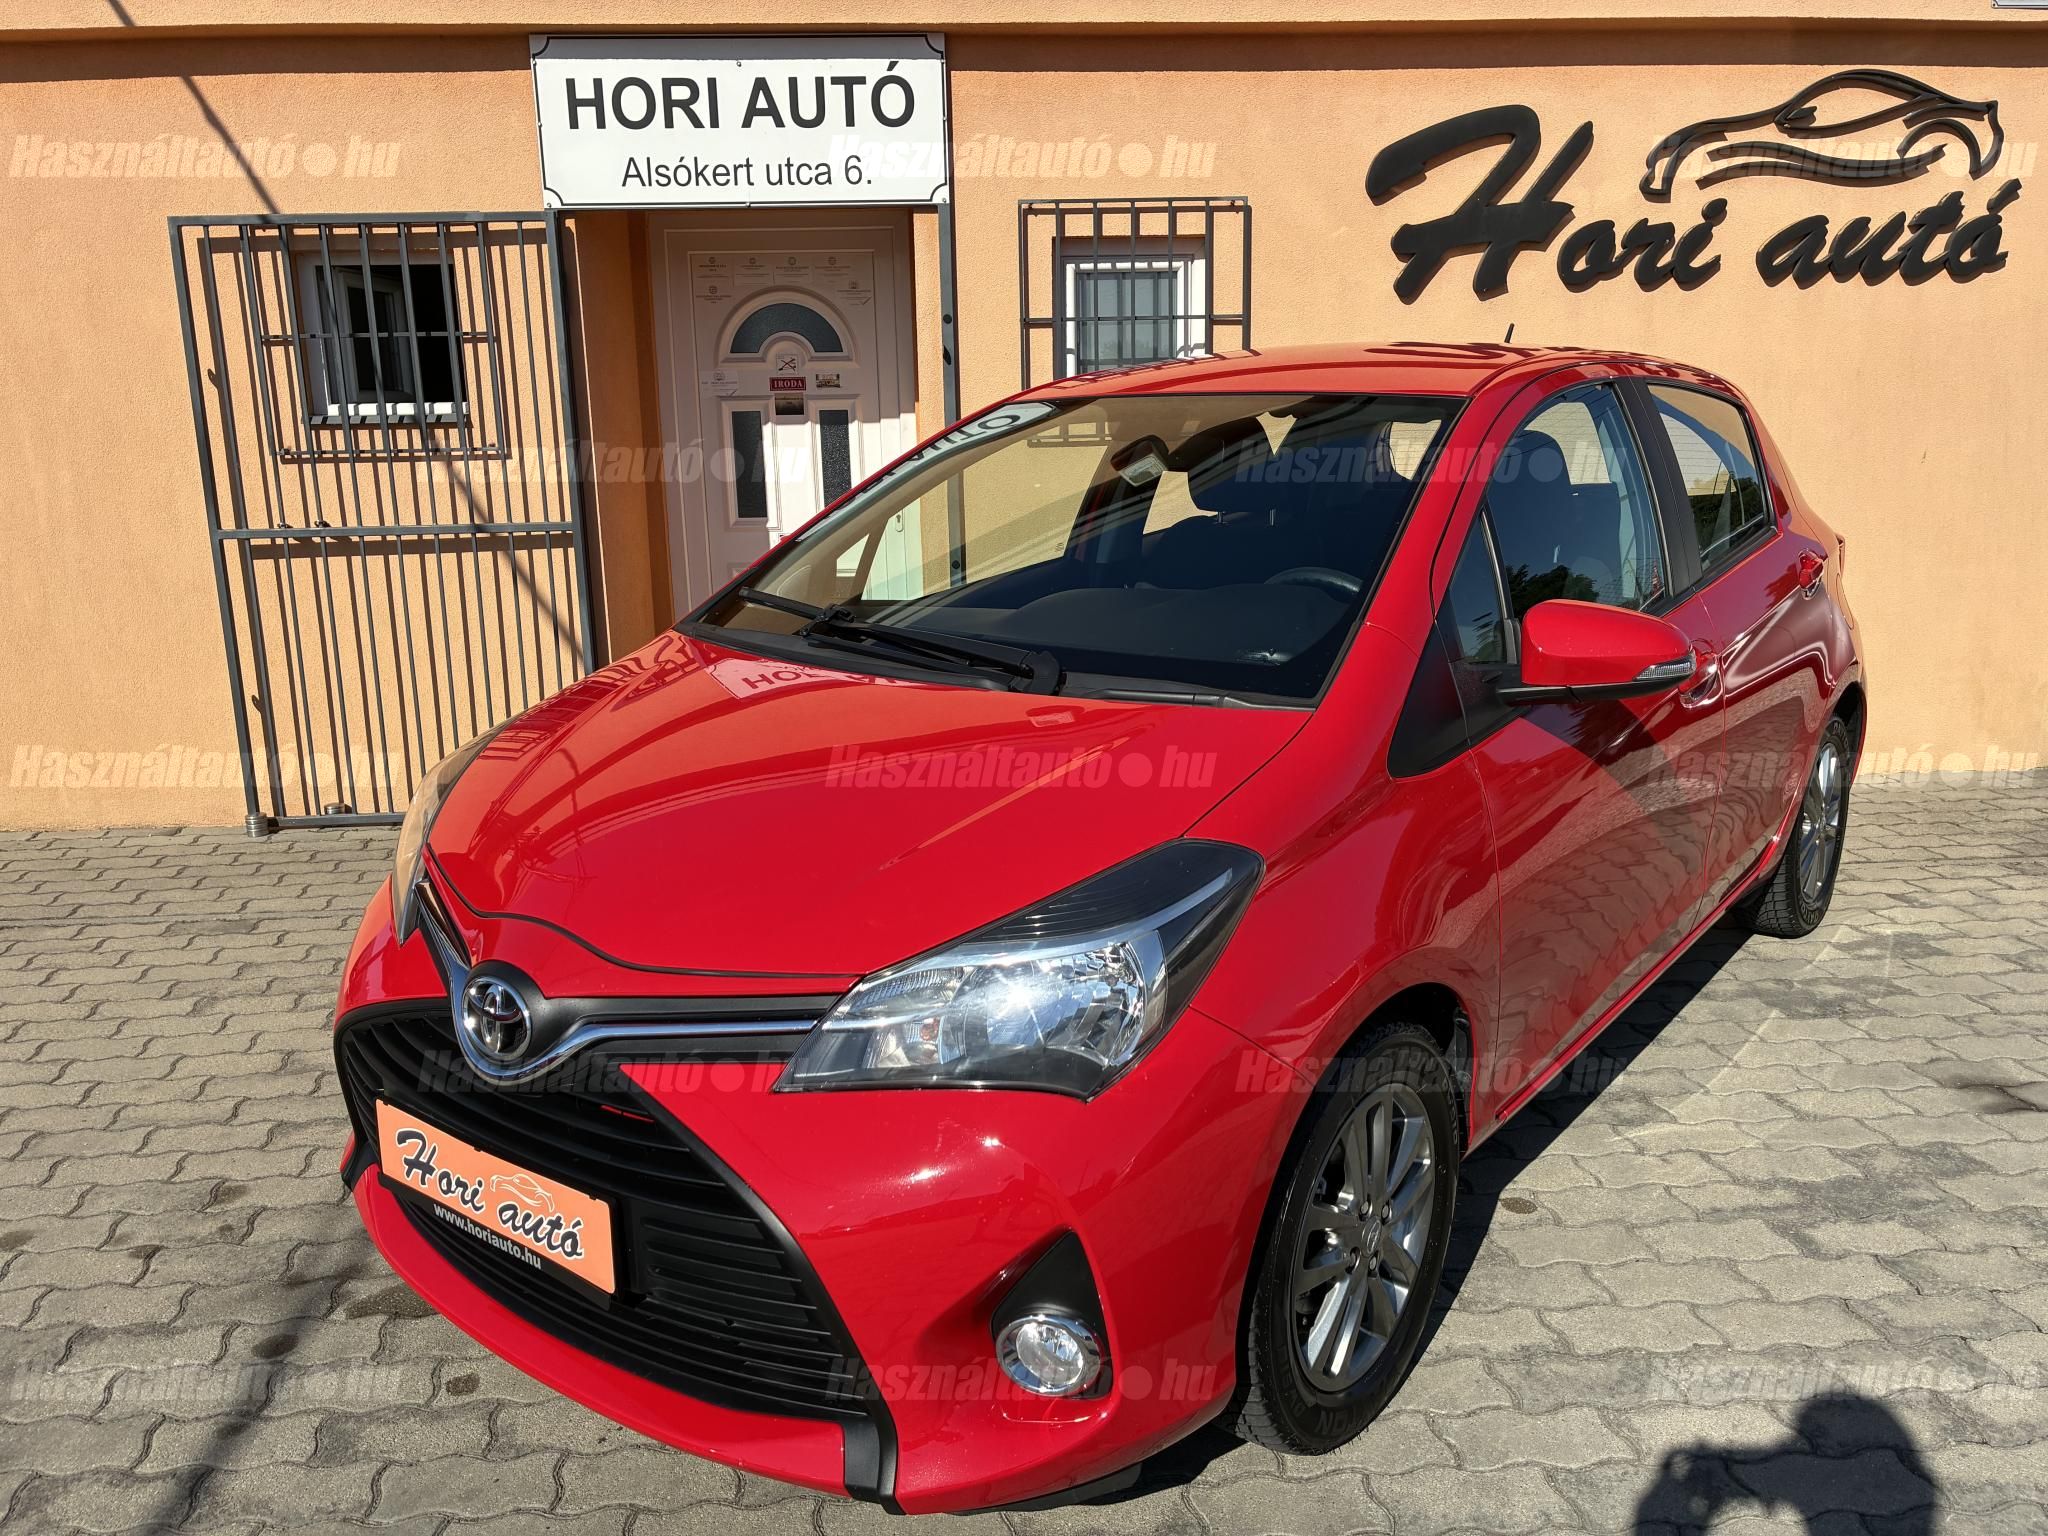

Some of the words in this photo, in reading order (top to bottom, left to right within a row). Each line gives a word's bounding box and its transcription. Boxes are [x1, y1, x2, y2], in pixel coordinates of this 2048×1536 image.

[565, 76, 719, 130] HORI
[742, 61, 915, 129] AUTÓ
[622, 157, 754, 187] Alsókert
[765, 159, 832, 186] utca
[844, 156, 873, 186] 6.
[1365, 105, 1727, 304] Hori
[1756, 178, 2021, 288] autó
[773, 379, 803, 389] IRODA
[396, 1128, 485, 1213] Hori
[498, 1202, 585, 1260] autó
[434, 1203, 542, 1271] www.horiauto.hu
